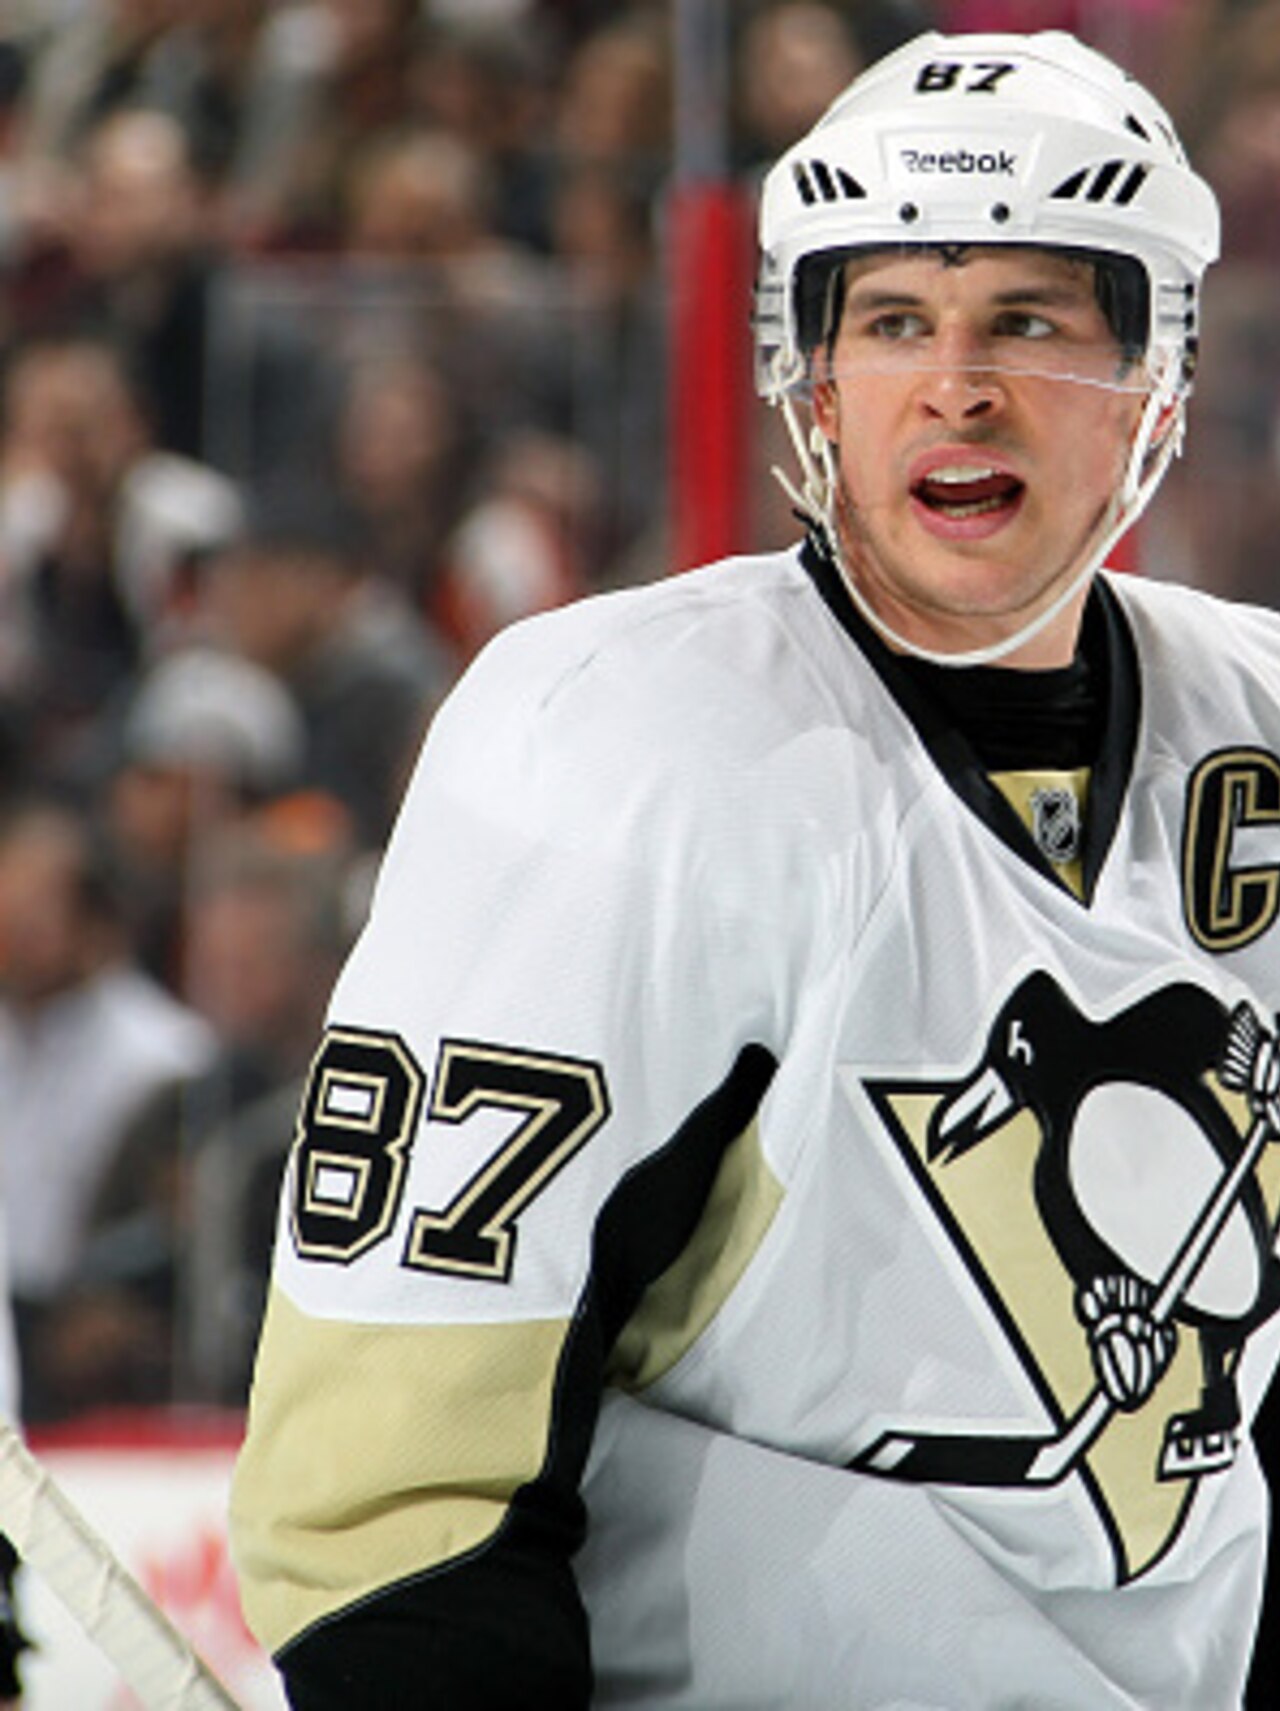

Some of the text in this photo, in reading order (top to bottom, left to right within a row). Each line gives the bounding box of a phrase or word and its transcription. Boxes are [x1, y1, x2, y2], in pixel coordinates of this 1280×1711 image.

[914, 61, 1016, 94] 87
[899, 149, 1018, 176] Reebok
[288, 1024, 612, 1284] 87
